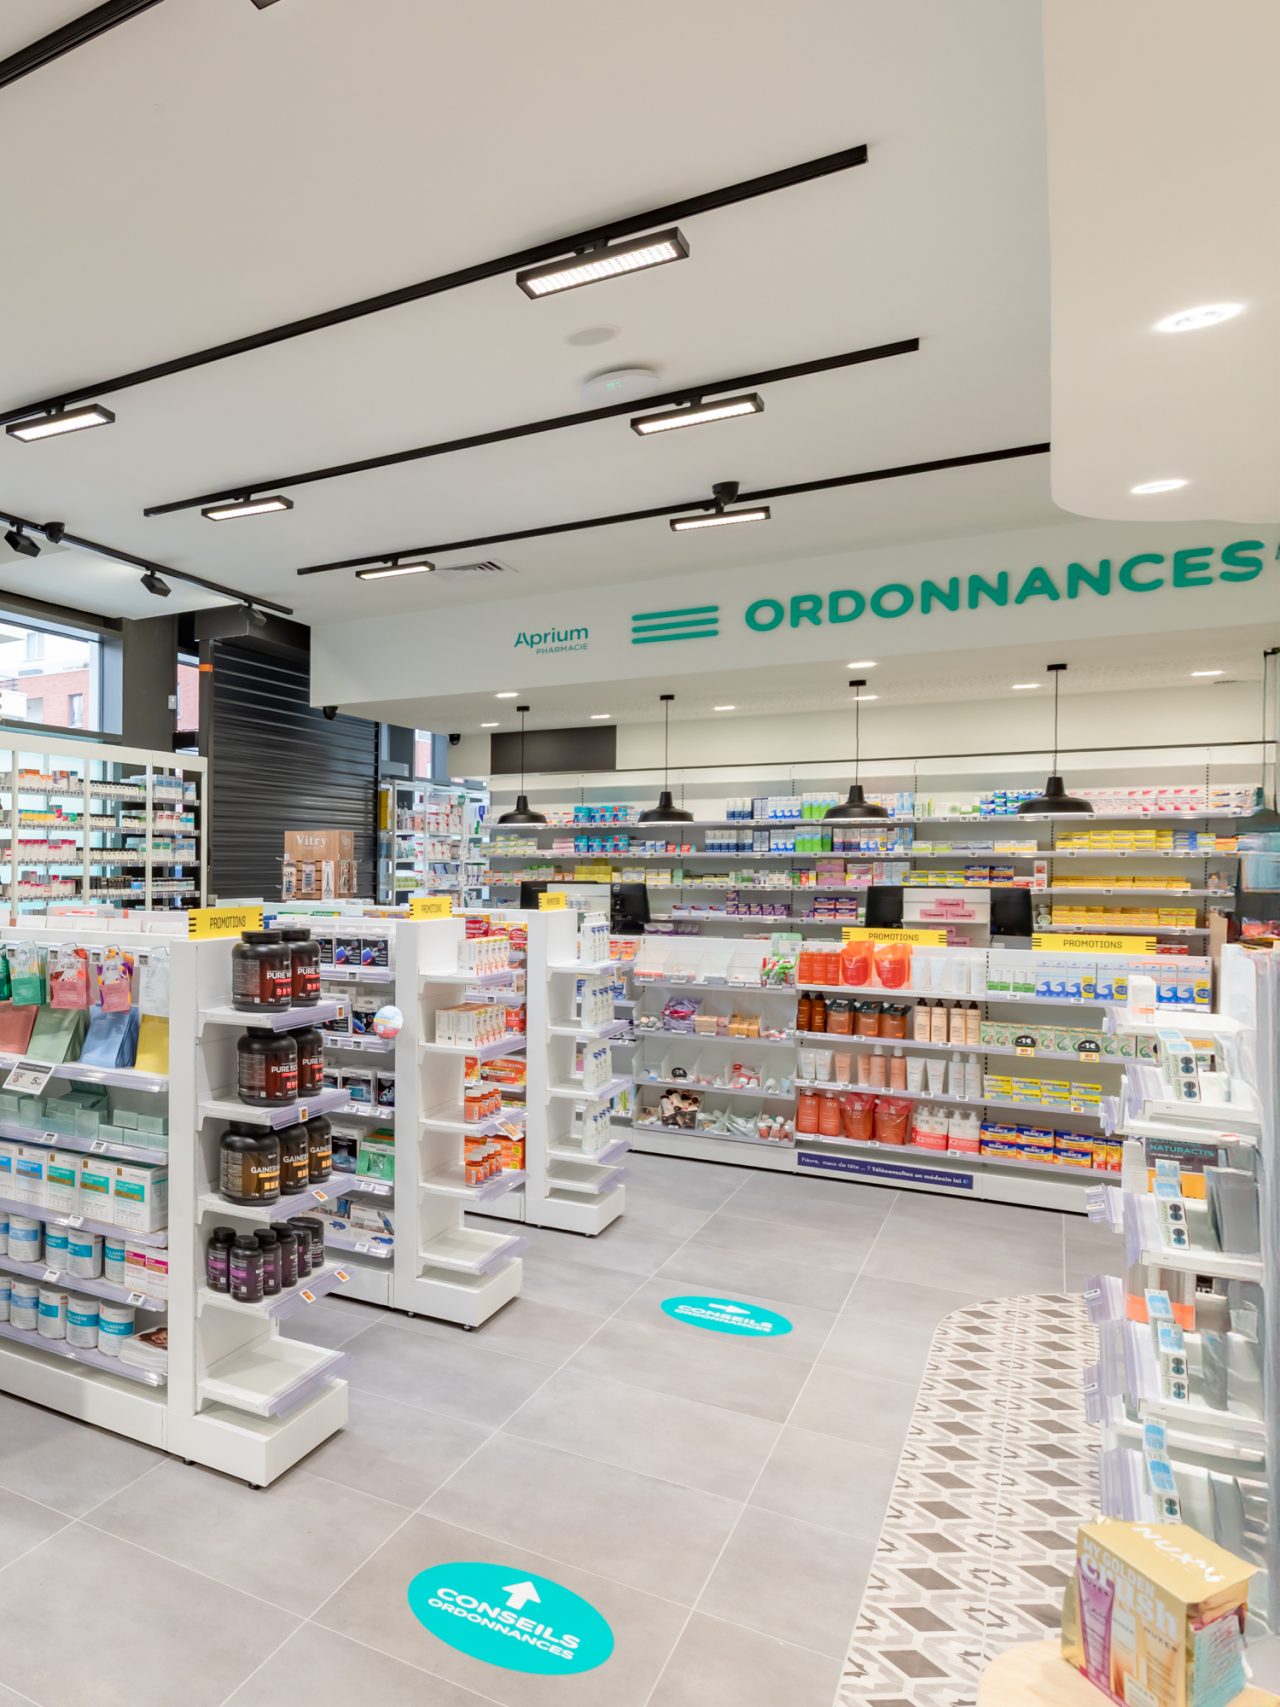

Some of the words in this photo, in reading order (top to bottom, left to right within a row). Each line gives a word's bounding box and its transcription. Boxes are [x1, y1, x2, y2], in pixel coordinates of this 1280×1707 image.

[745, 540, 1264, 632] ORDONNANCES
[514, 627, 588, 648] Aprium
[536, 643, 589, 655] PHARMACIE
[296, 835, 327, 848] Vitry
[209, 915, 247, 930] PROMOTIONS
[868, 932, 919, 942] PROMOTIONS
[1063, 939, 1123, 949] PROMOTIONS
[677, 1304, 773, 1329] CONSEILS
[436, 1587, 581, 1649] CONSEILS
[427, 1598, 574, 1660] ORDONNANCES
